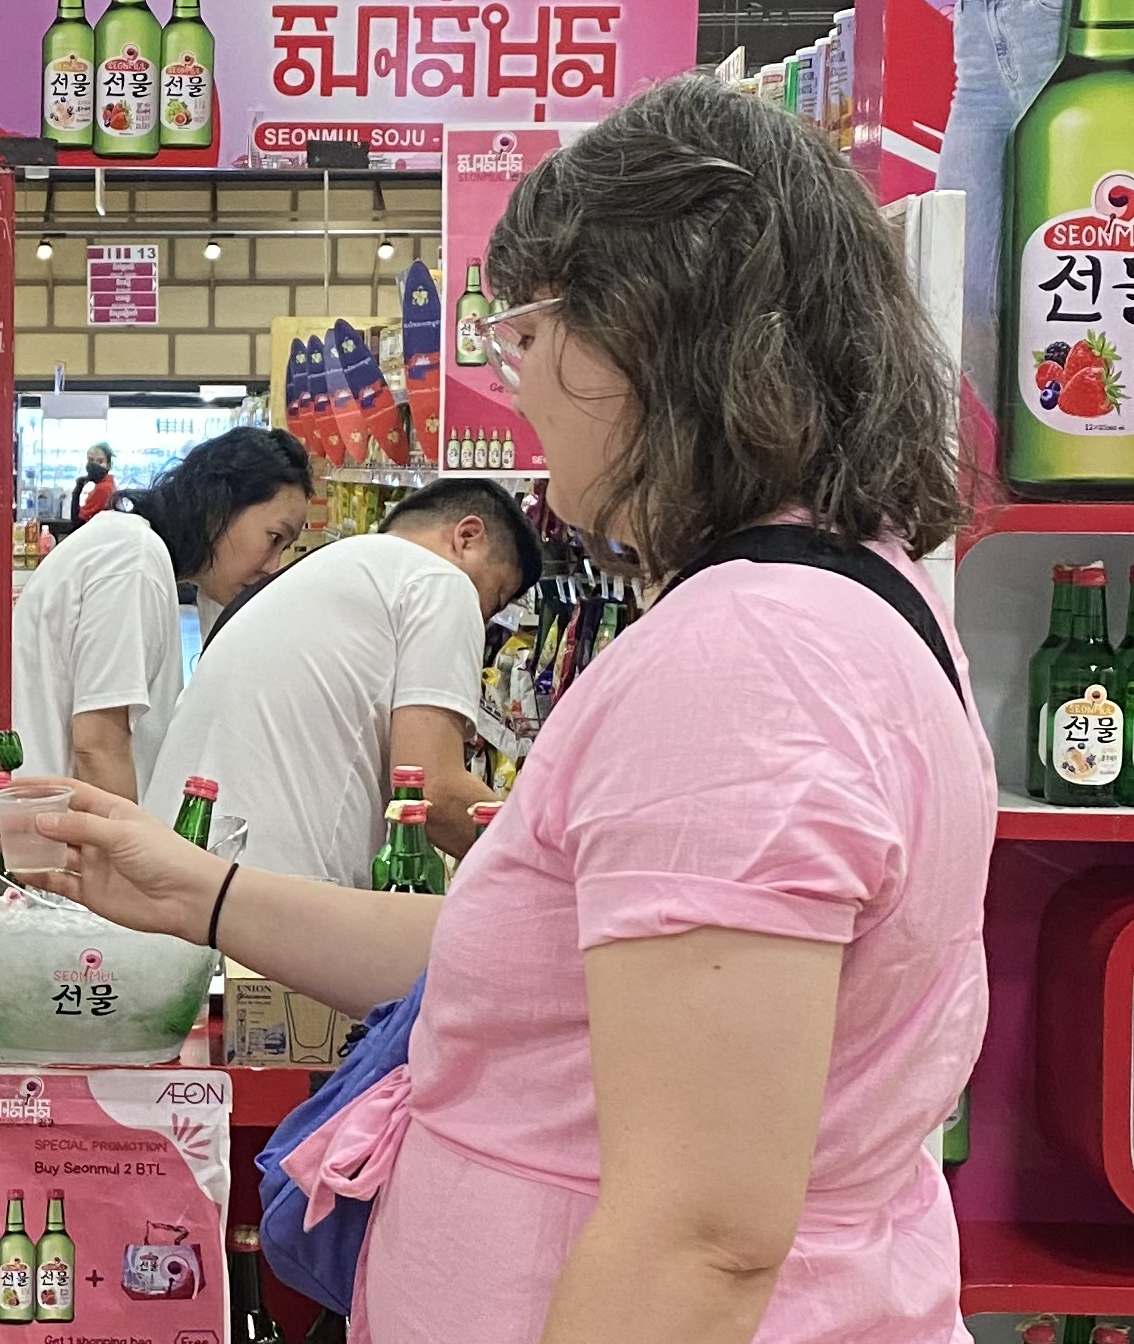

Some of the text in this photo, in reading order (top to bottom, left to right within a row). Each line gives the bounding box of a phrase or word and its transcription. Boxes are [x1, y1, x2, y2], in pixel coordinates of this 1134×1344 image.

[370, 128, 426, 146] SOJU
[1052, 223, 1134, 247] SEONM
[137, 247, 157, 259] 13
[52, 969, 119, 983] SEONMUL
[34, 1139, 168, 1152] SPECIAL PROMOTION
[34, 1162, 166, 1177] Buy Seonmul 2 BTL
